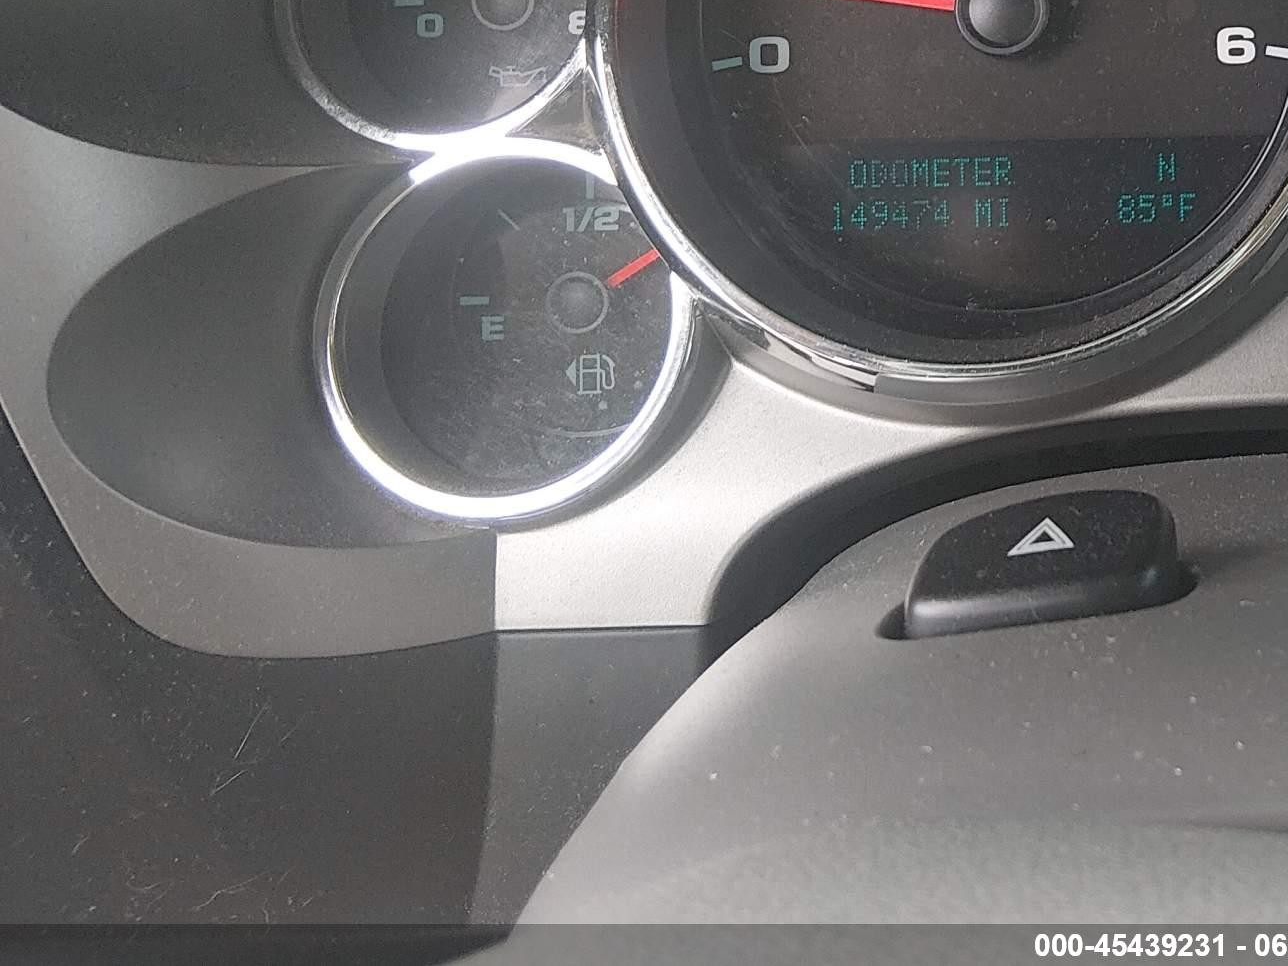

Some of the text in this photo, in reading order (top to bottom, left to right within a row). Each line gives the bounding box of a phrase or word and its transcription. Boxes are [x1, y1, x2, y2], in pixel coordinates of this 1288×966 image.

[416, 14, 444, 38] 0
[750, 37, 790, 74] 0
[1216, 28, 1256, 64] 6
[849, 156, 1014, 188] ODOMETER
[1158, 152, 1176, 183] N
[562, 206, 620, 232] 1/2
[832, 198, 1009, 232] 149474 MI
[481, 316, 504, 341] E
